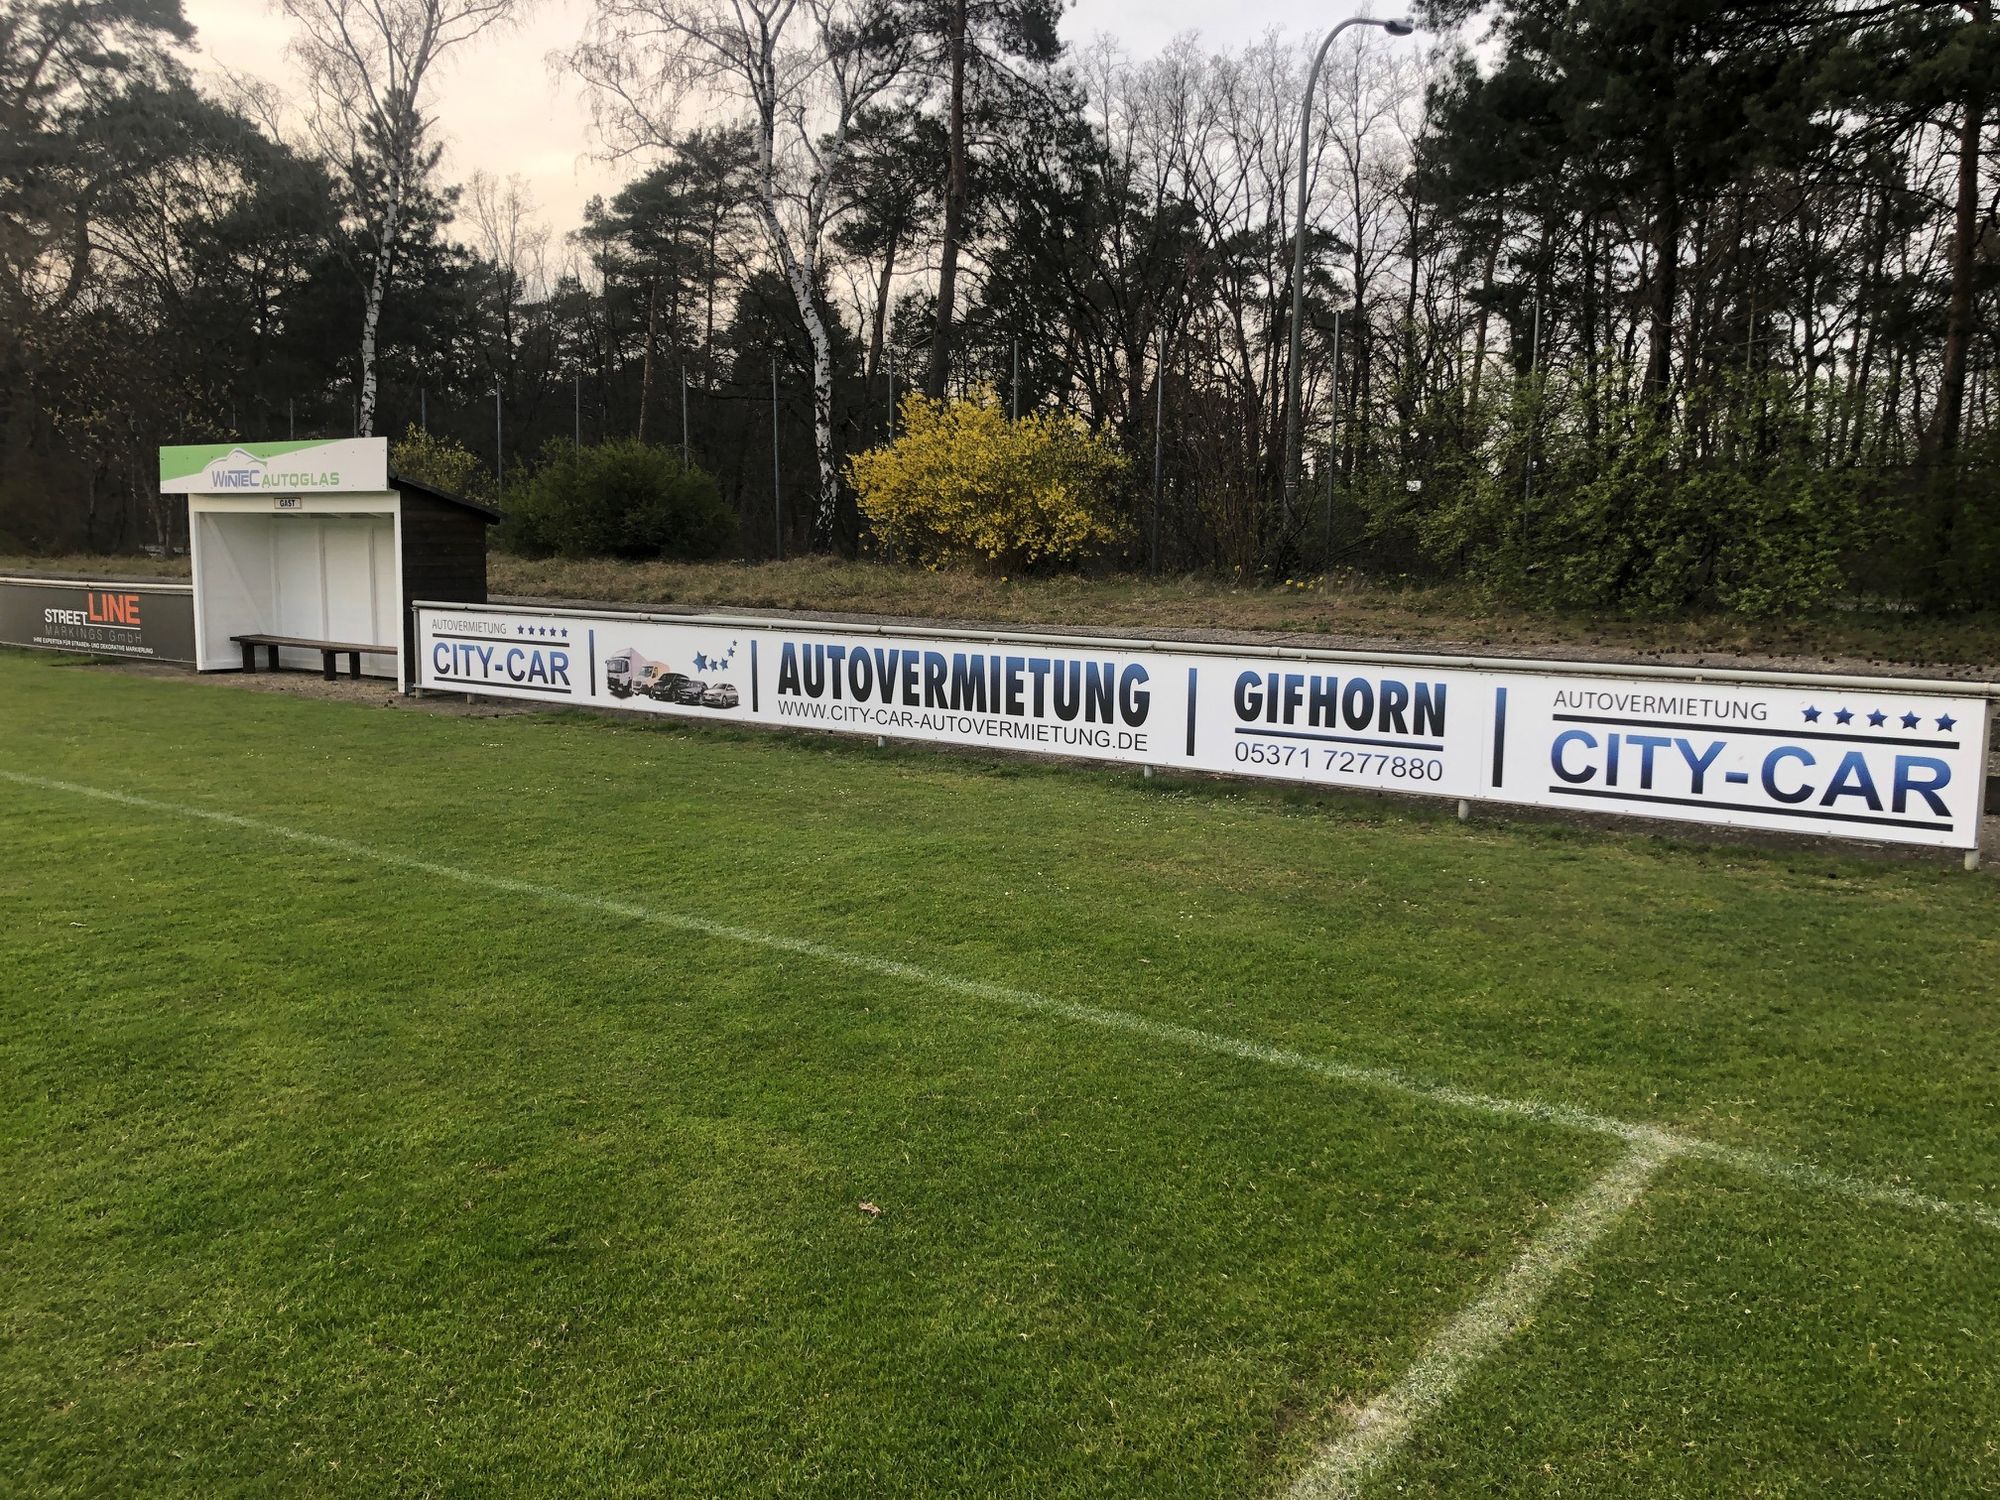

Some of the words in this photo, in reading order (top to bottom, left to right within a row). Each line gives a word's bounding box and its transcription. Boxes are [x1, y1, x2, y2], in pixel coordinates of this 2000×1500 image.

[262, 472, 340, 488] AUTOGLAS
[279, 499, 296, 507] GAST
[44, 608, 87, 626] STREET
[88, 592, 141, 624] LINE
[432, 618, 507, 635] AUTOVERMIETUNG
[44, 624, 103, 640] MARKINGS
[109, 630, 142, 643] GmbH
[433, 641, 571, 686] CITY-CAR
[777, 641, 1151, 728] AUTOVERMIETUNG
[1234, 670, 1447, 737] GIFHORN
[1553, 689, 1767, 722] AUTOVERMIETUNG
[777, 699, 1149, 752] WWW.CITY-CAR-AUTOVERMIETUNG.DE
[1235, 741, 1310, 768] 05371
[1323, 749, 1443, 781] 7277880
[1550, 729, 1953, 817] CITY-CAR
